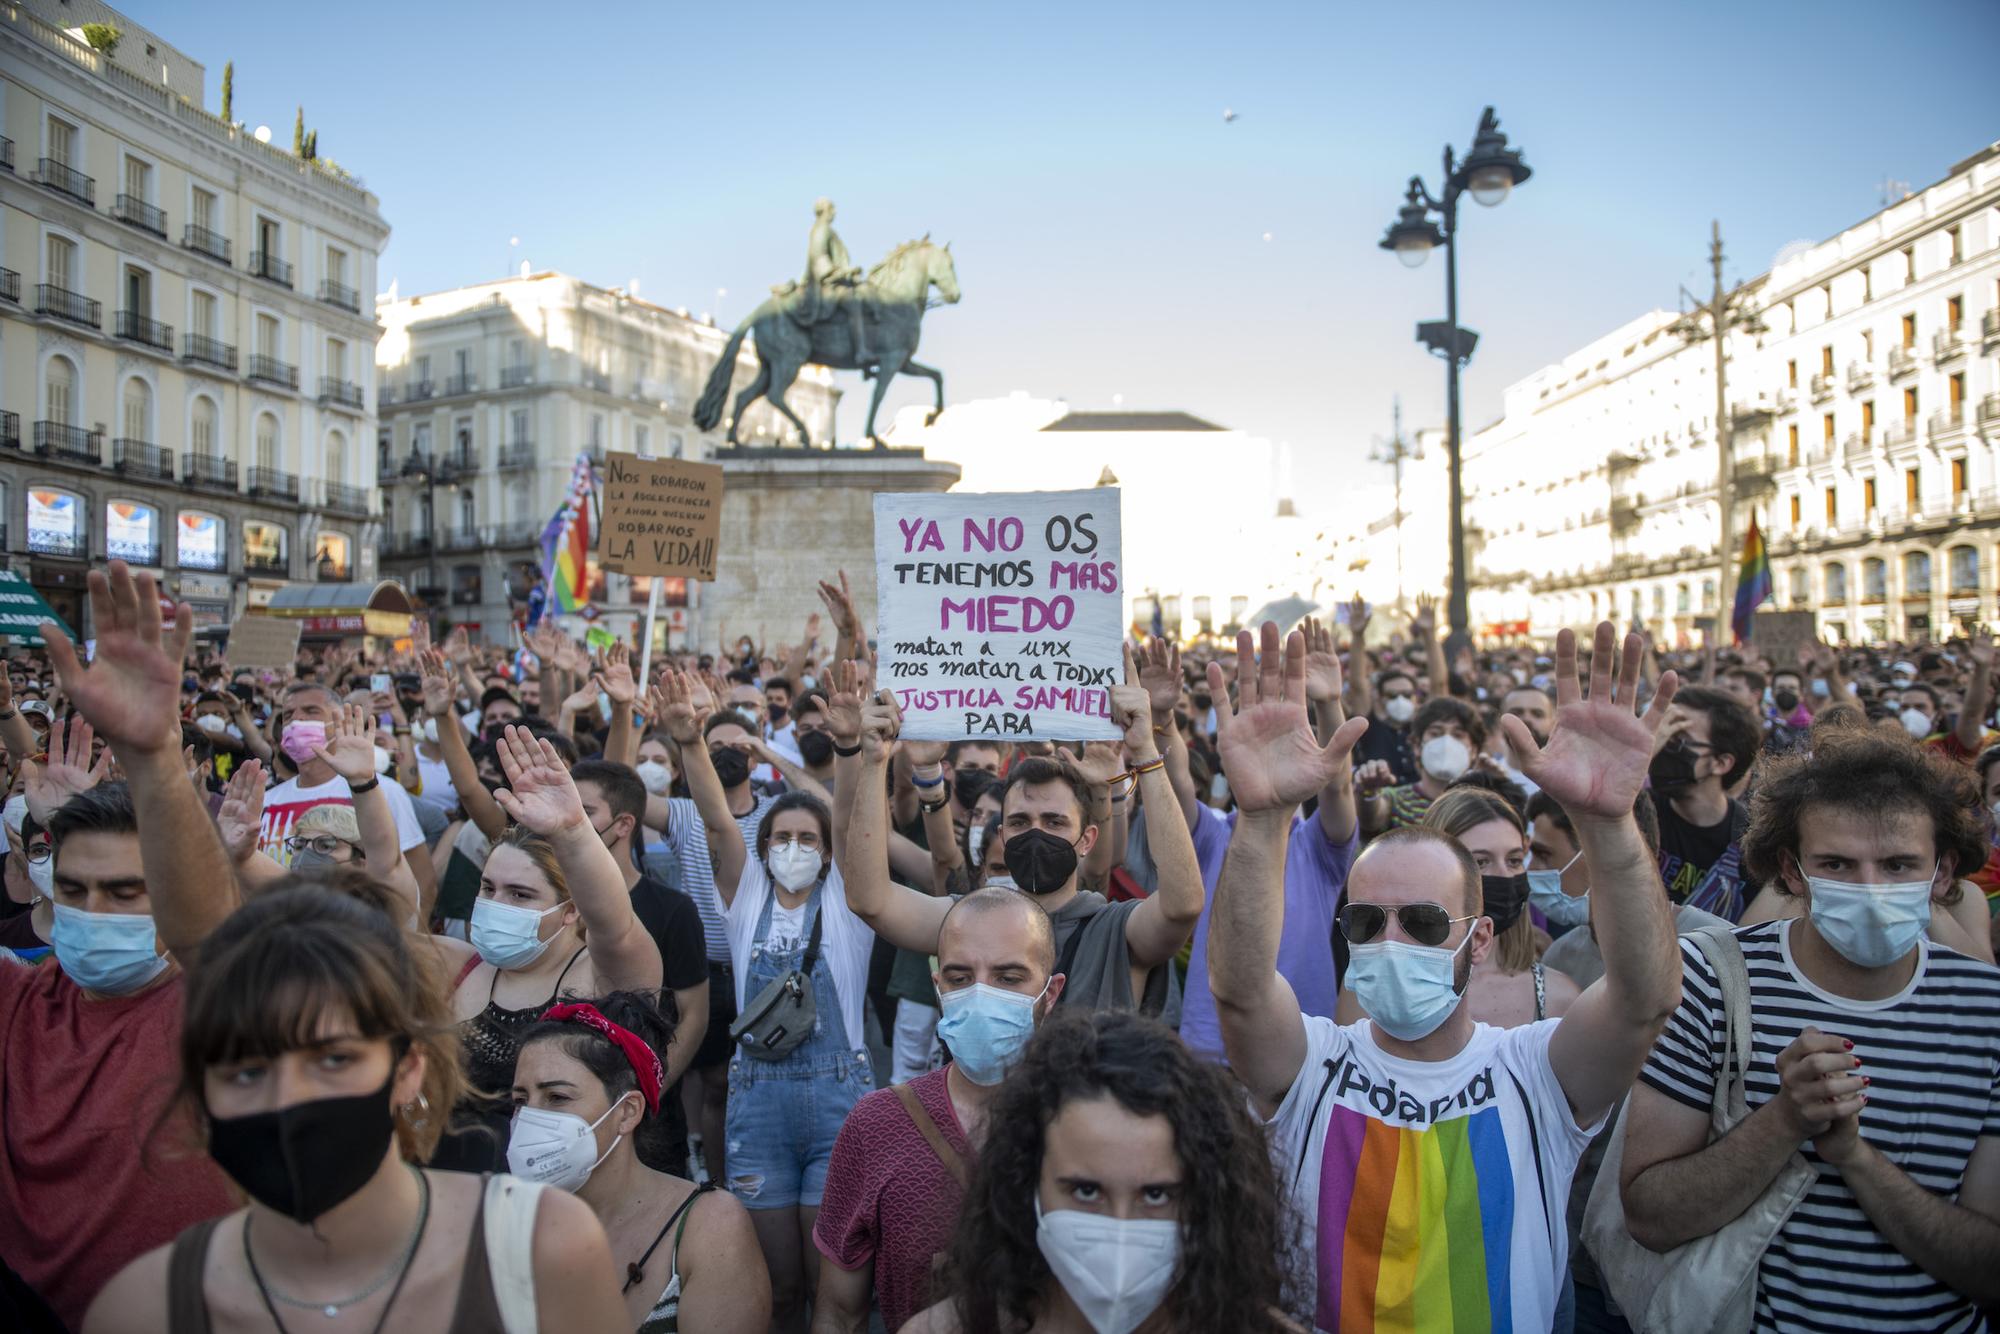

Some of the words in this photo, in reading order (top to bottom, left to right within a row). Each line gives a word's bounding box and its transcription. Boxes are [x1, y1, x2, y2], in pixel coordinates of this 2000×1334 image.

[651, 474, 706, 491] ROBARON
[611, 491, 624, 500] LA
[612, 506, 618, 514] Y
[625, 508, 657, 516] AHORA
[618, 522, 695, 538] ROBARNOS
[899, 517, 945, 554] YA
[963, 516, 1024, 553] NO
[1045, 512, 1098, 554] OS
[608, 537, 635, 560] LA
[654, 537, 714, 576] VIDA!!
[894, 560, 1034, 588] TENEMOS
[1049, 552, 1118, 594] MÁS
[941, 595, 1075, 633] MIEDO
[894, 636, 963, 657] matan
[980, 644, 995, 656] a
[1019, 640, 1072, 658] unx
[890, 661, 928, 677] nos
[939, 658, 1025, 681] matan
[1029, 663, 1047, 680] a
[896, 687, 1004, 712] JUSTICIA
[1013, 686, 1112, 718] SAMUEL
[965, 712, 1033, 735] PARA
